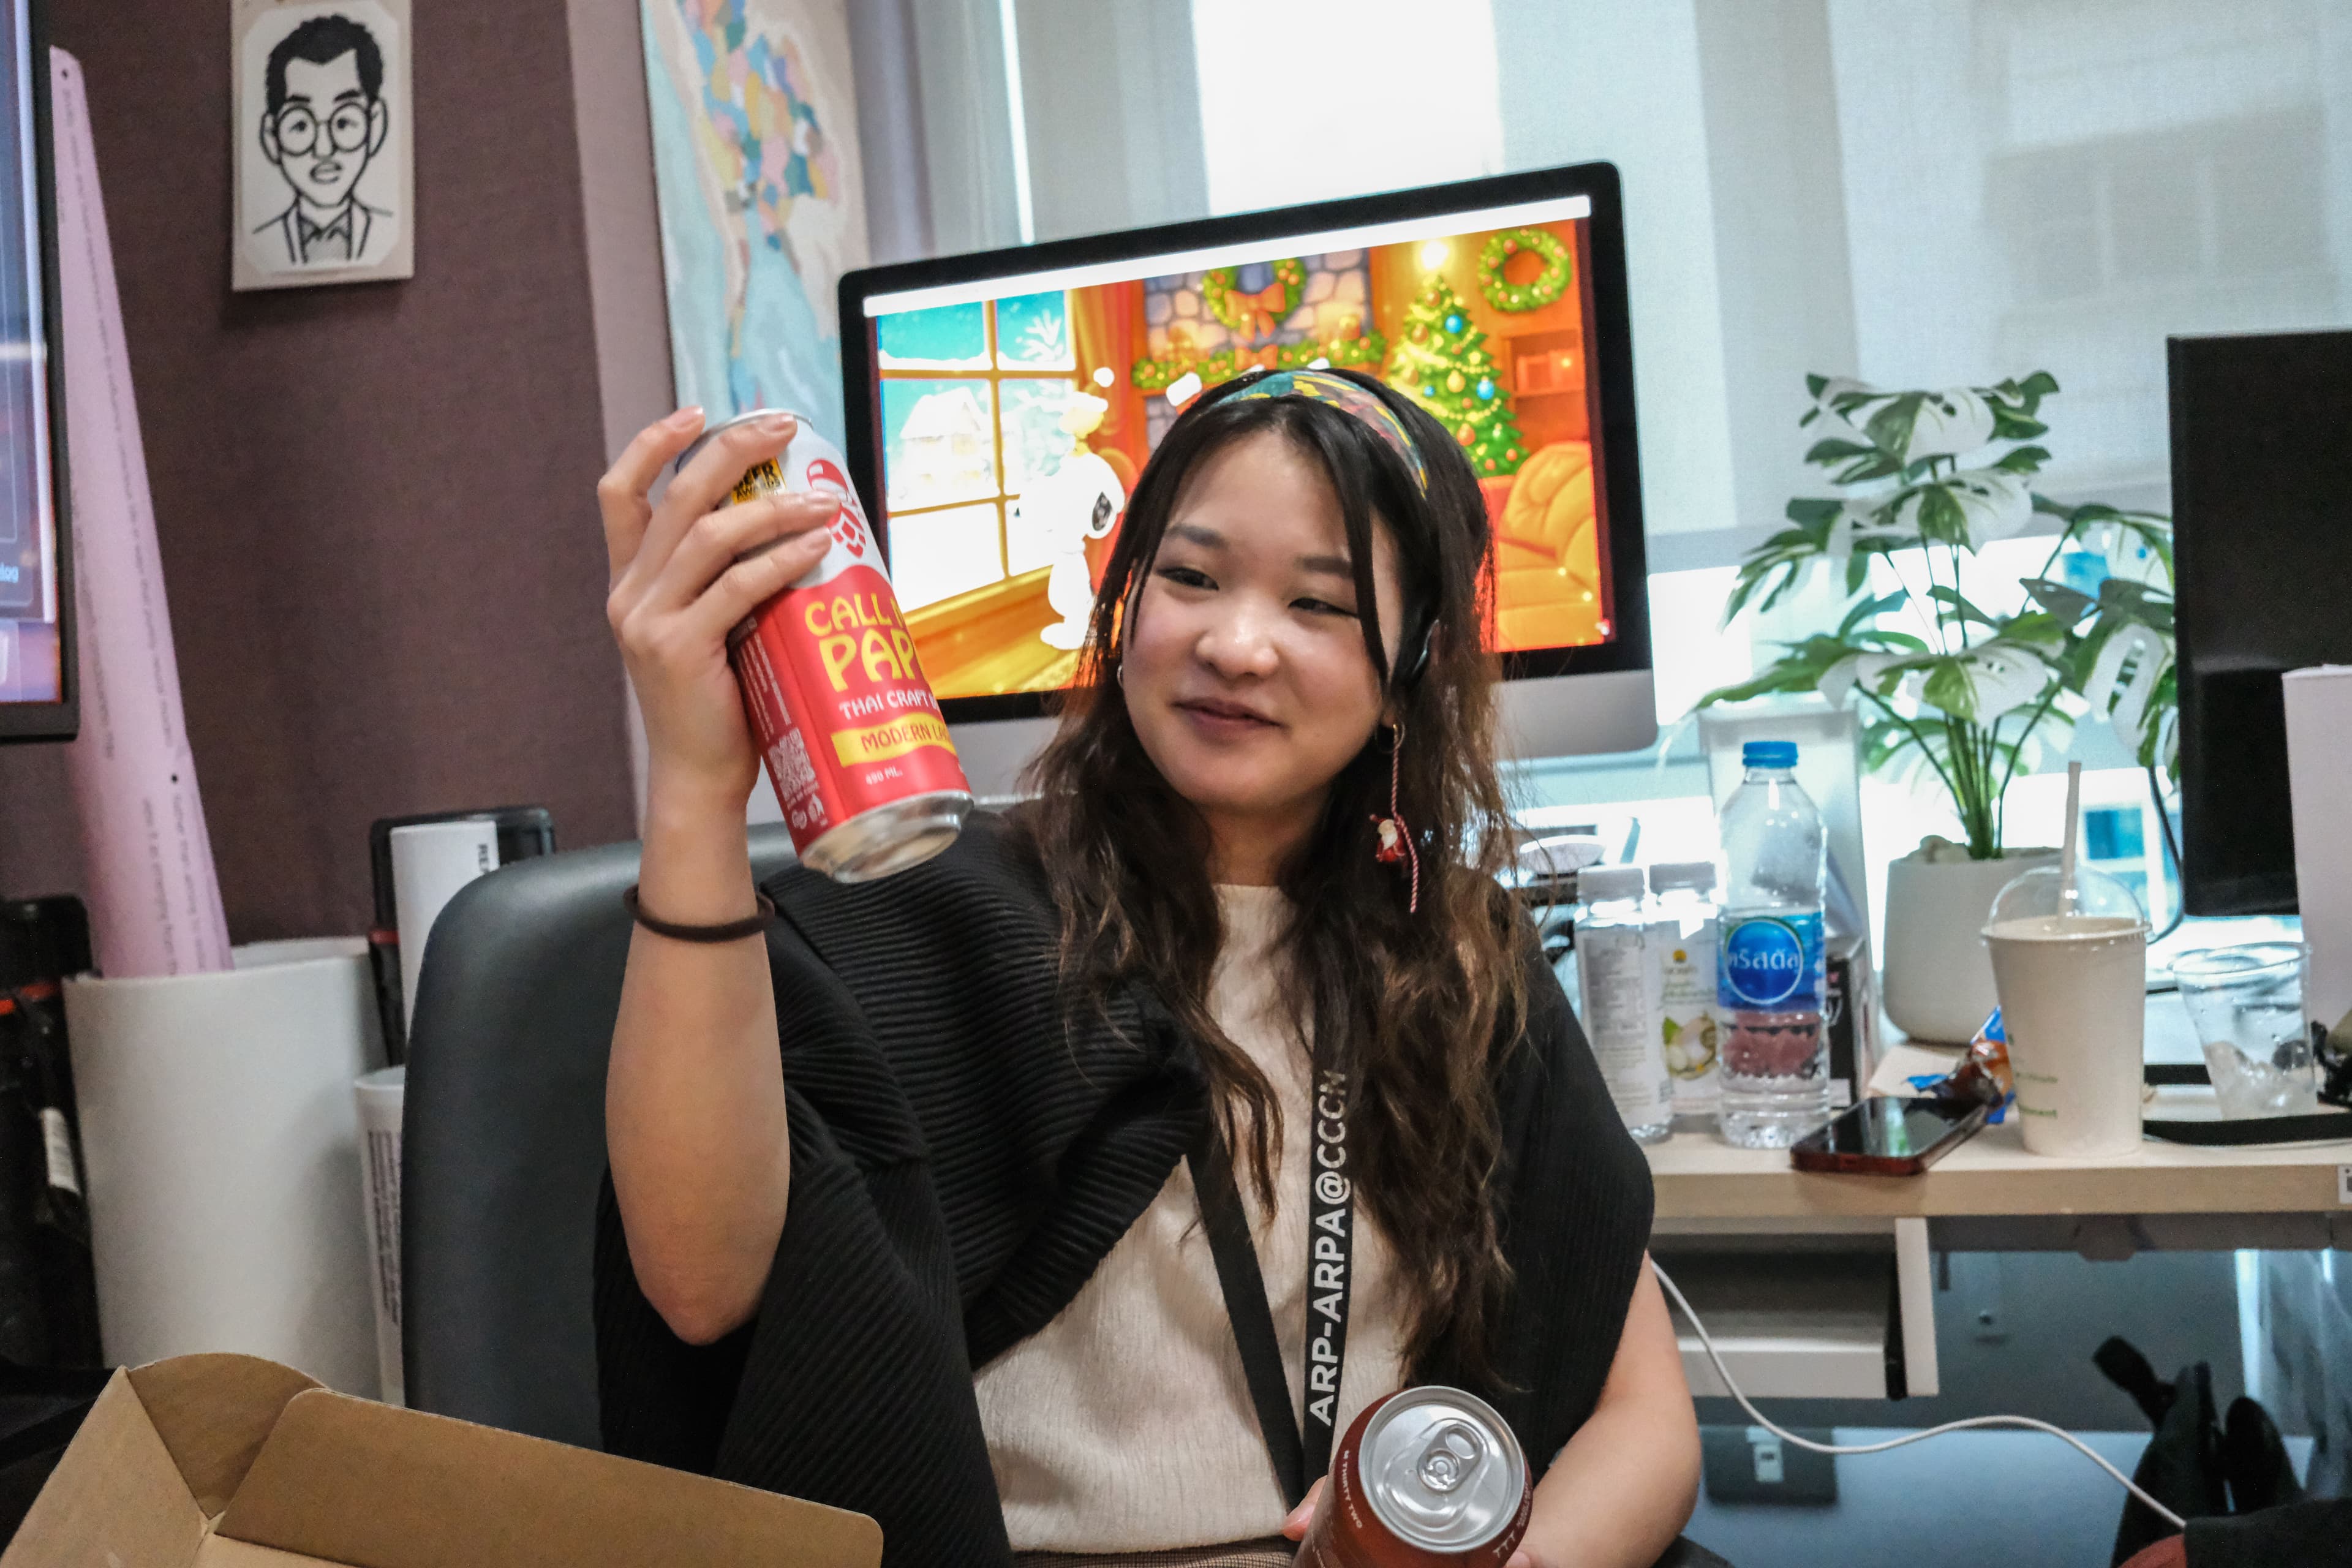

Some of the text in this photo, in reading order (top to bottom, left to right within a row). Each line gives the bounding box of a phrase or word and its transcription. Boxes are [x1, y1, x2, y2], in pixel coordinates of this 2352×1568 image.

[805, 593, 892, 636] CALL
[839, 693, 885, 720] THAI
[886, 688, 929, 709] CRAFT
[861, 722, 932, 753] MODERN
[1342, 1461, 1351, 1501] THIRTY
[1349, 1503, 1363, 1529] TWO
